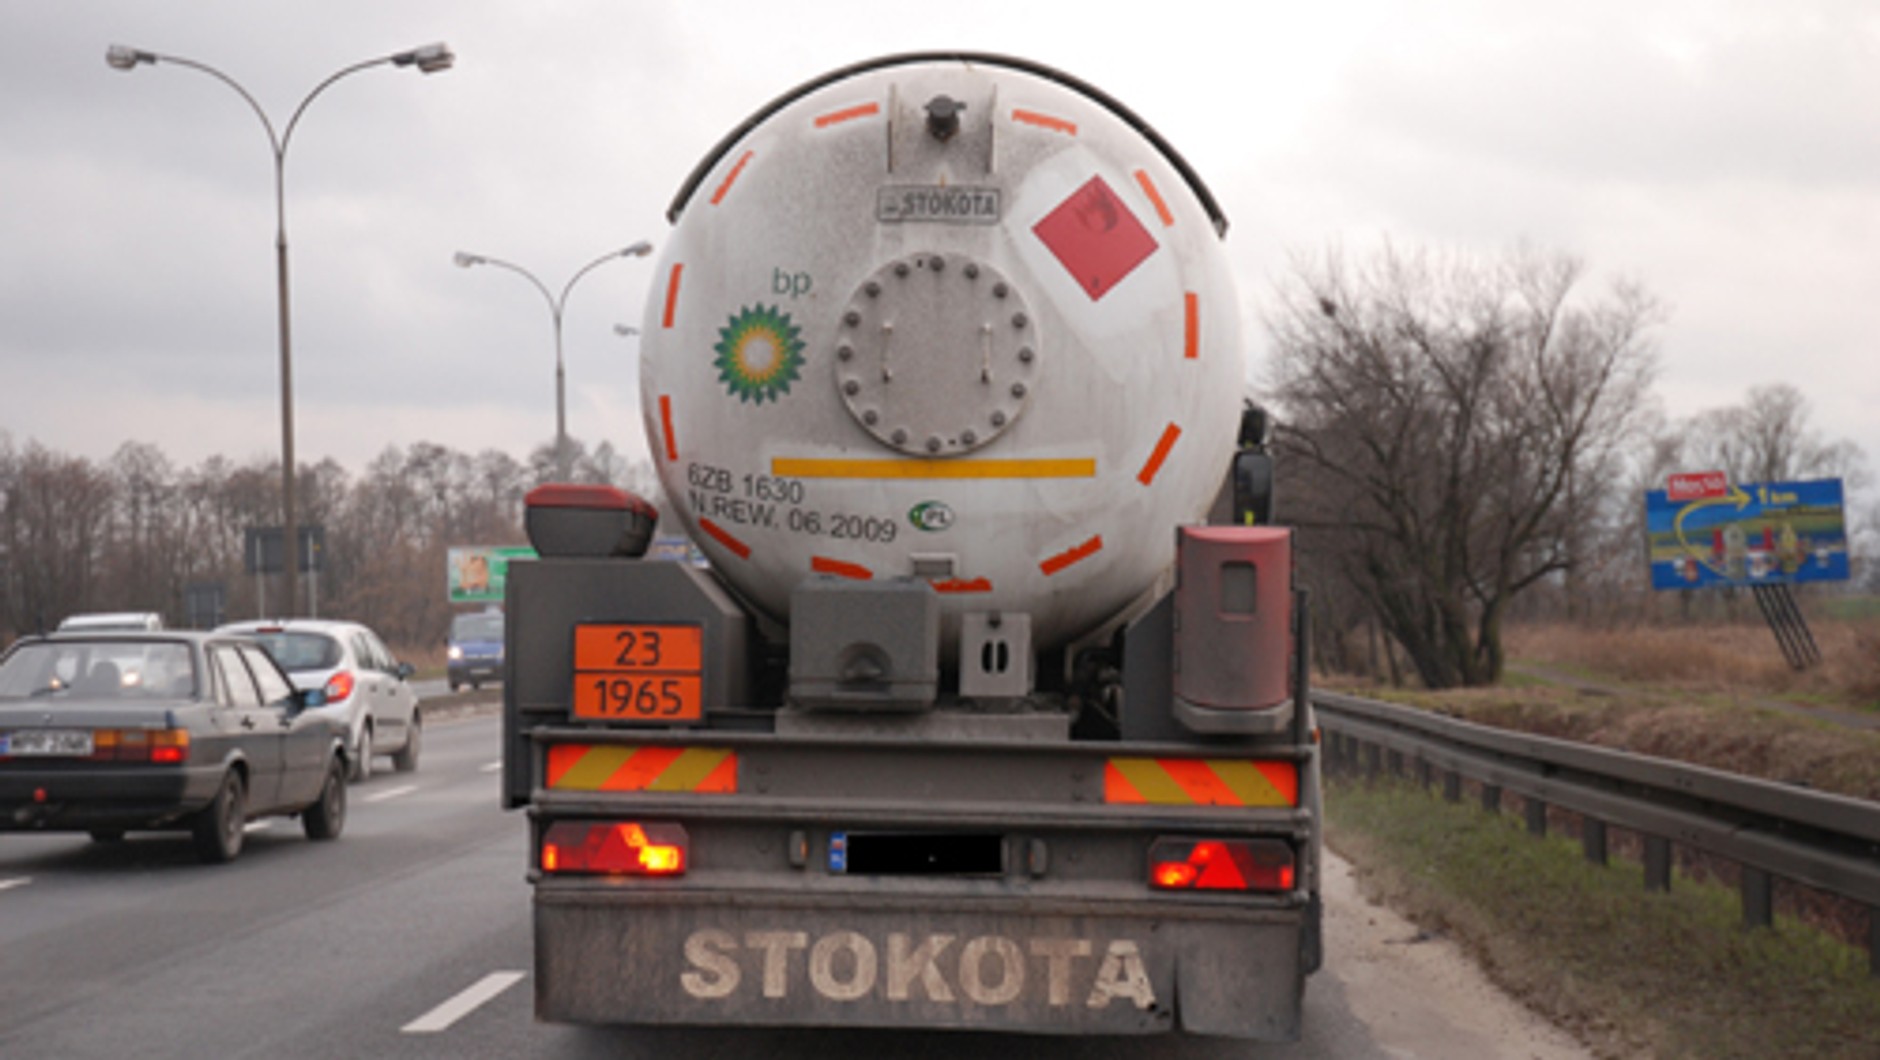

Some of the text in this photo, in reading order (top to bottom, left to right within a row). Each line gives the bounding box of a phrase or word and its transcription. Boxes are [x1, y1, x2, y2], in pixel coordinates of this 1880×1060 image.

[902, 191, 995, 216] STOKOTA
[772, 267, 813, 299] bp
[687, 462, 804, 505] 6ZB 1630
[688, 489, 897, 543] N.REW. 06.2009
[615, 630, 661, 666] 23
[594, 679, 682, 715] 1965
[680, 930, 1156, 1009] STOKOTA
